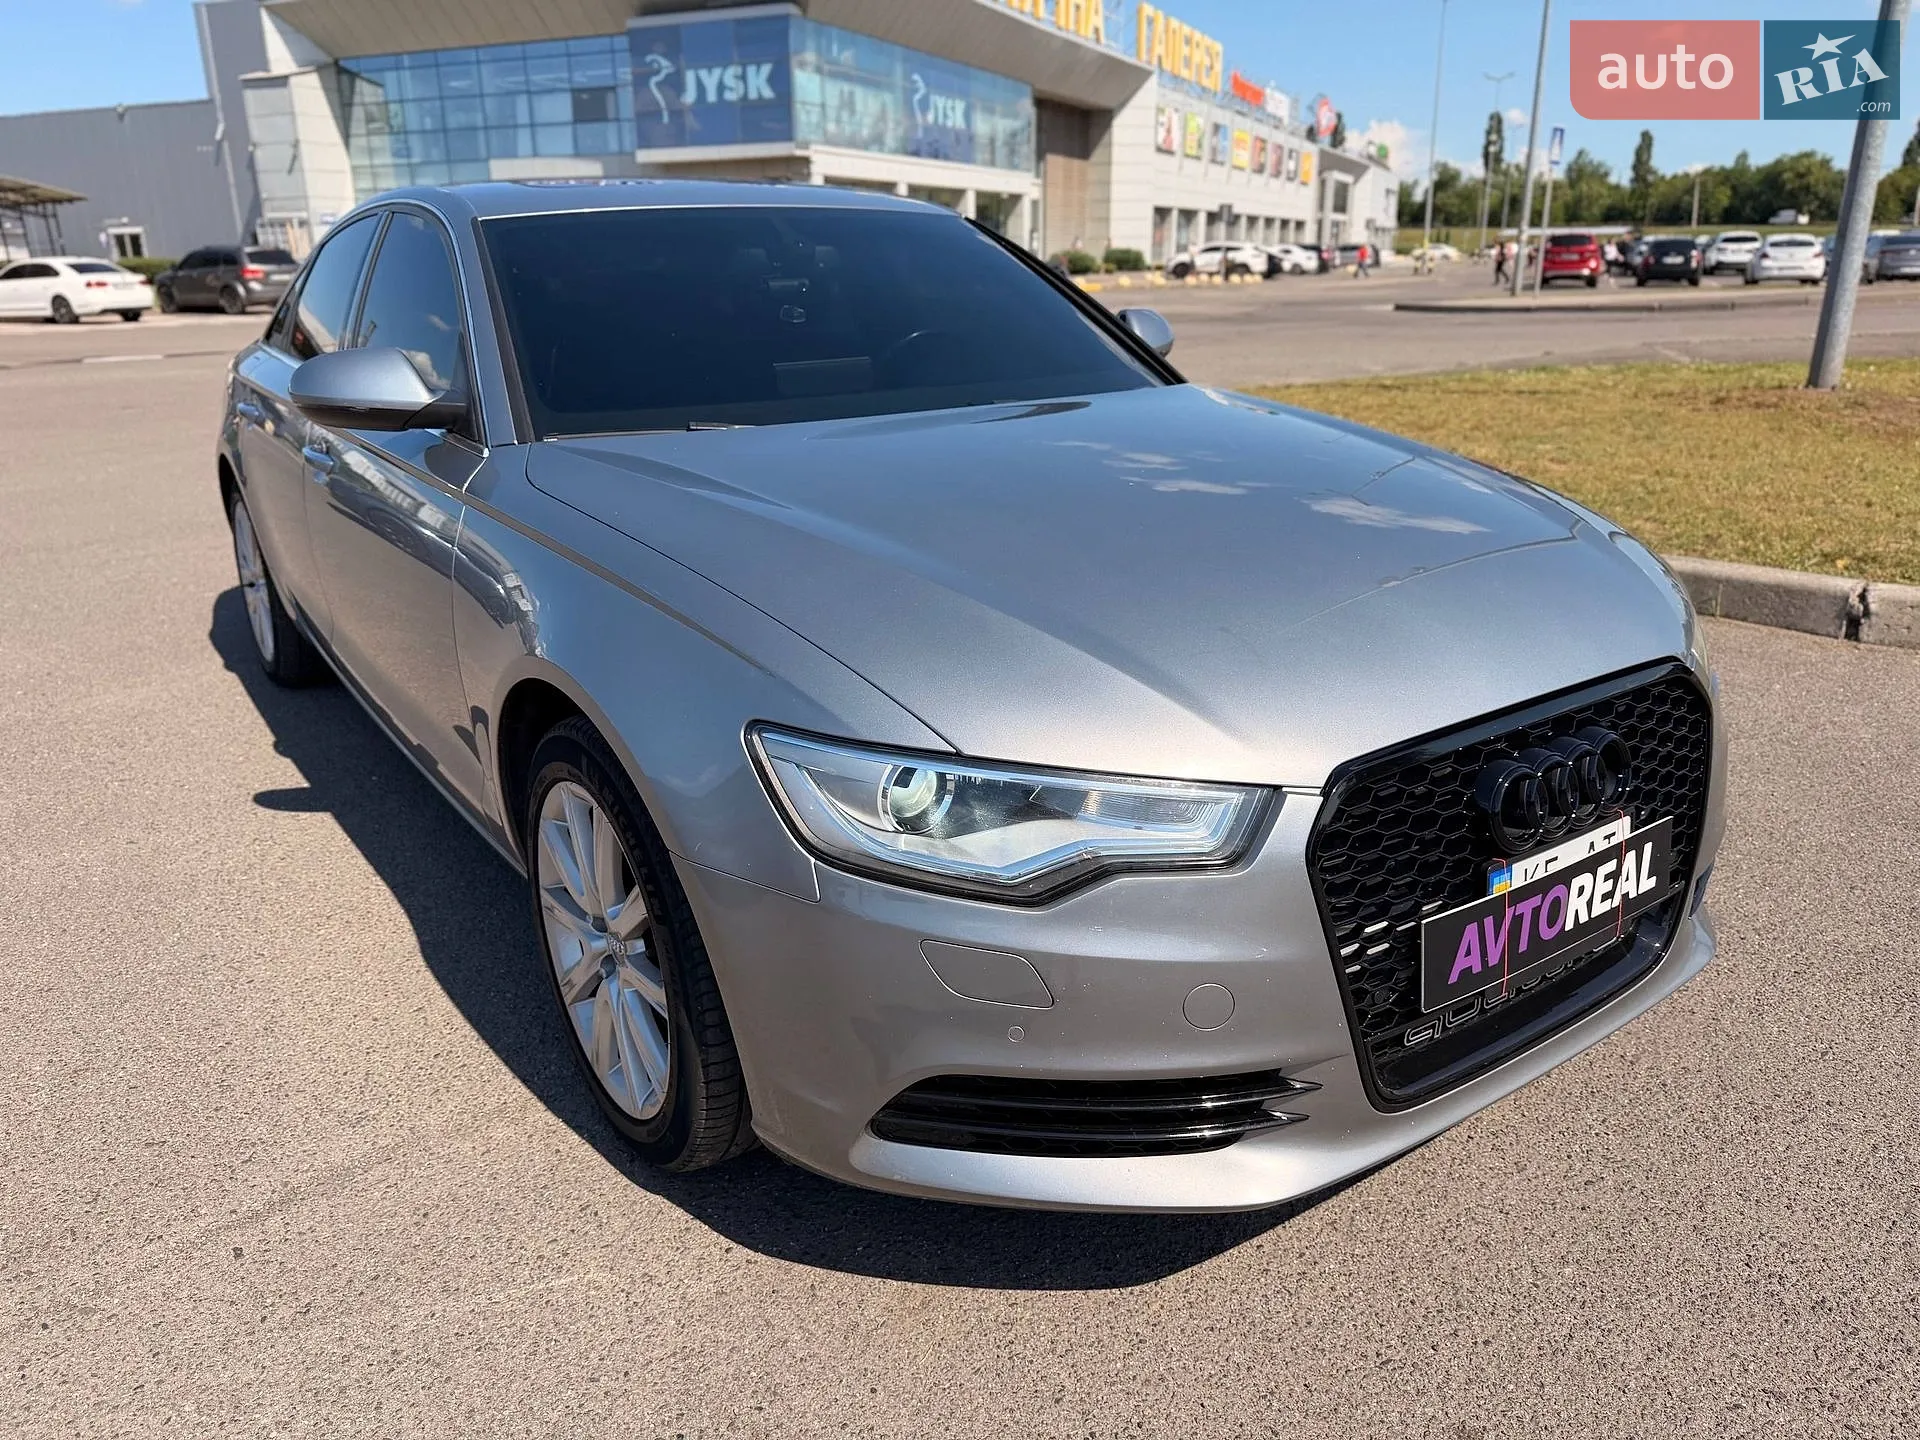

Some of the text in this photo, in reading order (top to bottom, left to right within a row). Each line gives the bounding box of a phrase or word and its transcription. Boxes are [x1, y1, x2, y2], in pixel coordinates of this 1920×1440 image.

[1137, 2, 1223, 93] ГАЛЕРЕЯ
[680, 63, 775, 105] JYSK
[927, 94, 967, 129] JYSK
[1447, 841, 1657, 985] AVTOREAL
